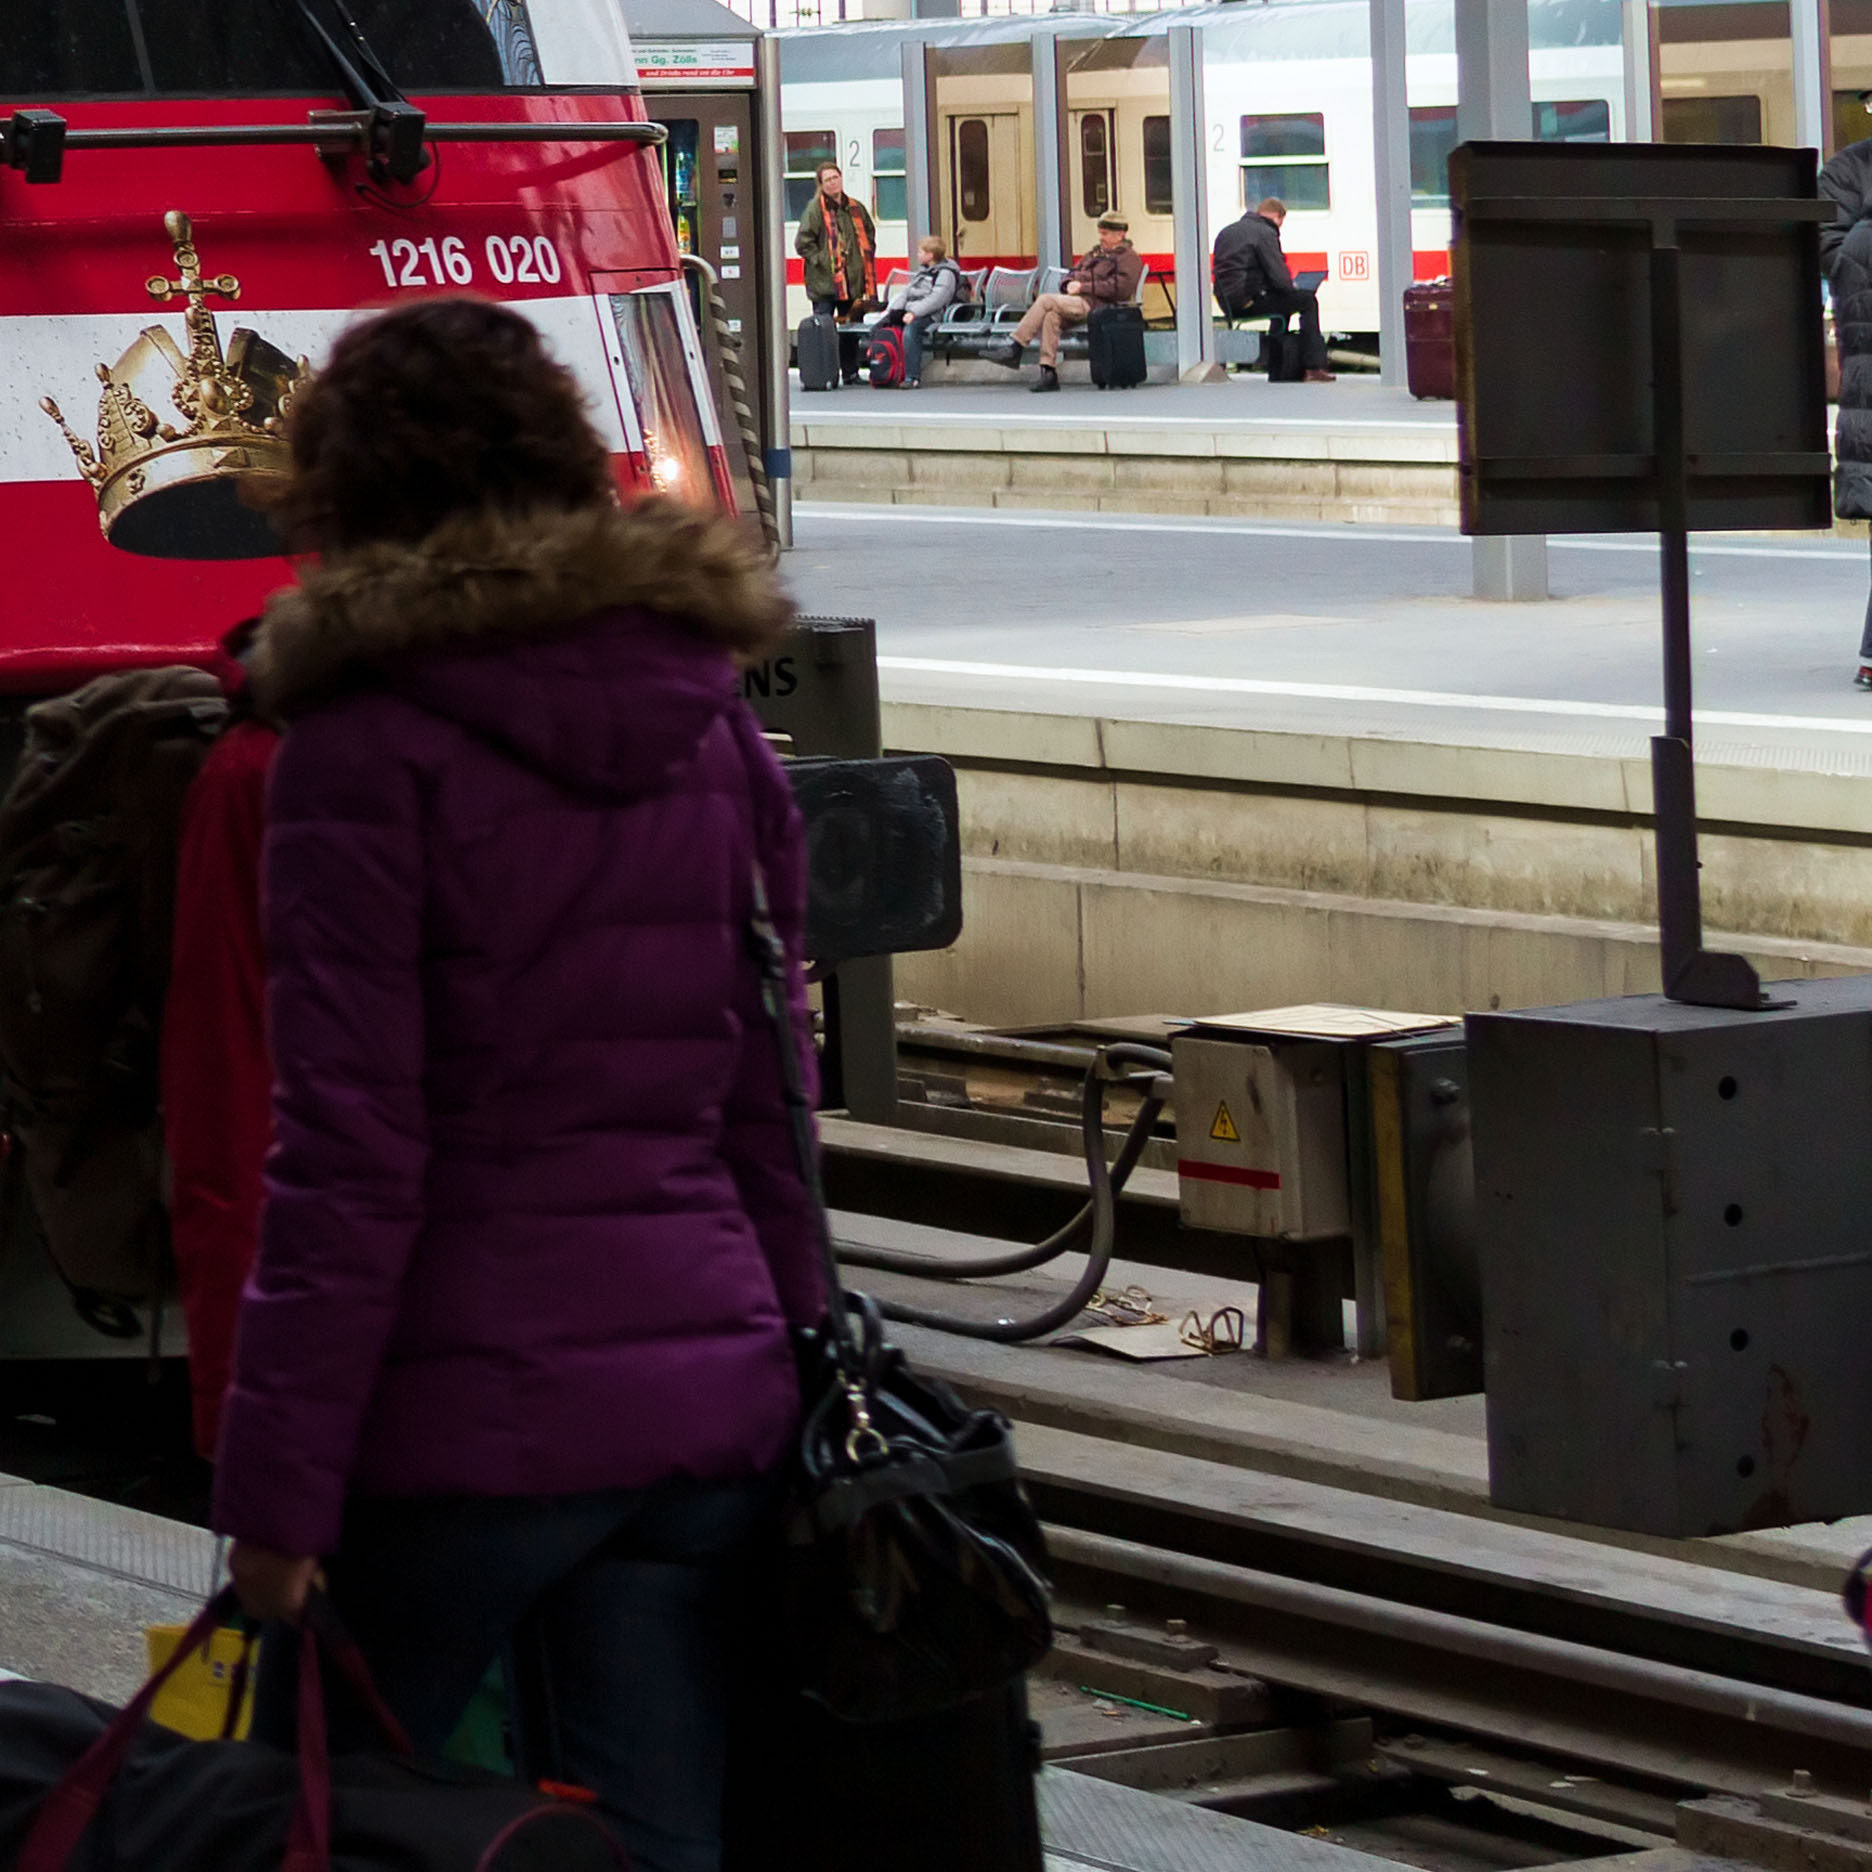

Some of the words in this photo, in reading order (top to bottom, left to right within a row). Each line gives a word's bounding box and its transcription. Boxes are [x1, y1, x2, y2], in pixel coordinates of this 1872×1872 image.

[1212, 123, 1224, 152] 2
[849, 140, 860, 167] 2
[369, 236, 473, 287] 1216
[485, 235, 561, 284] 020
[1341, 254, 1367, 277] DB
